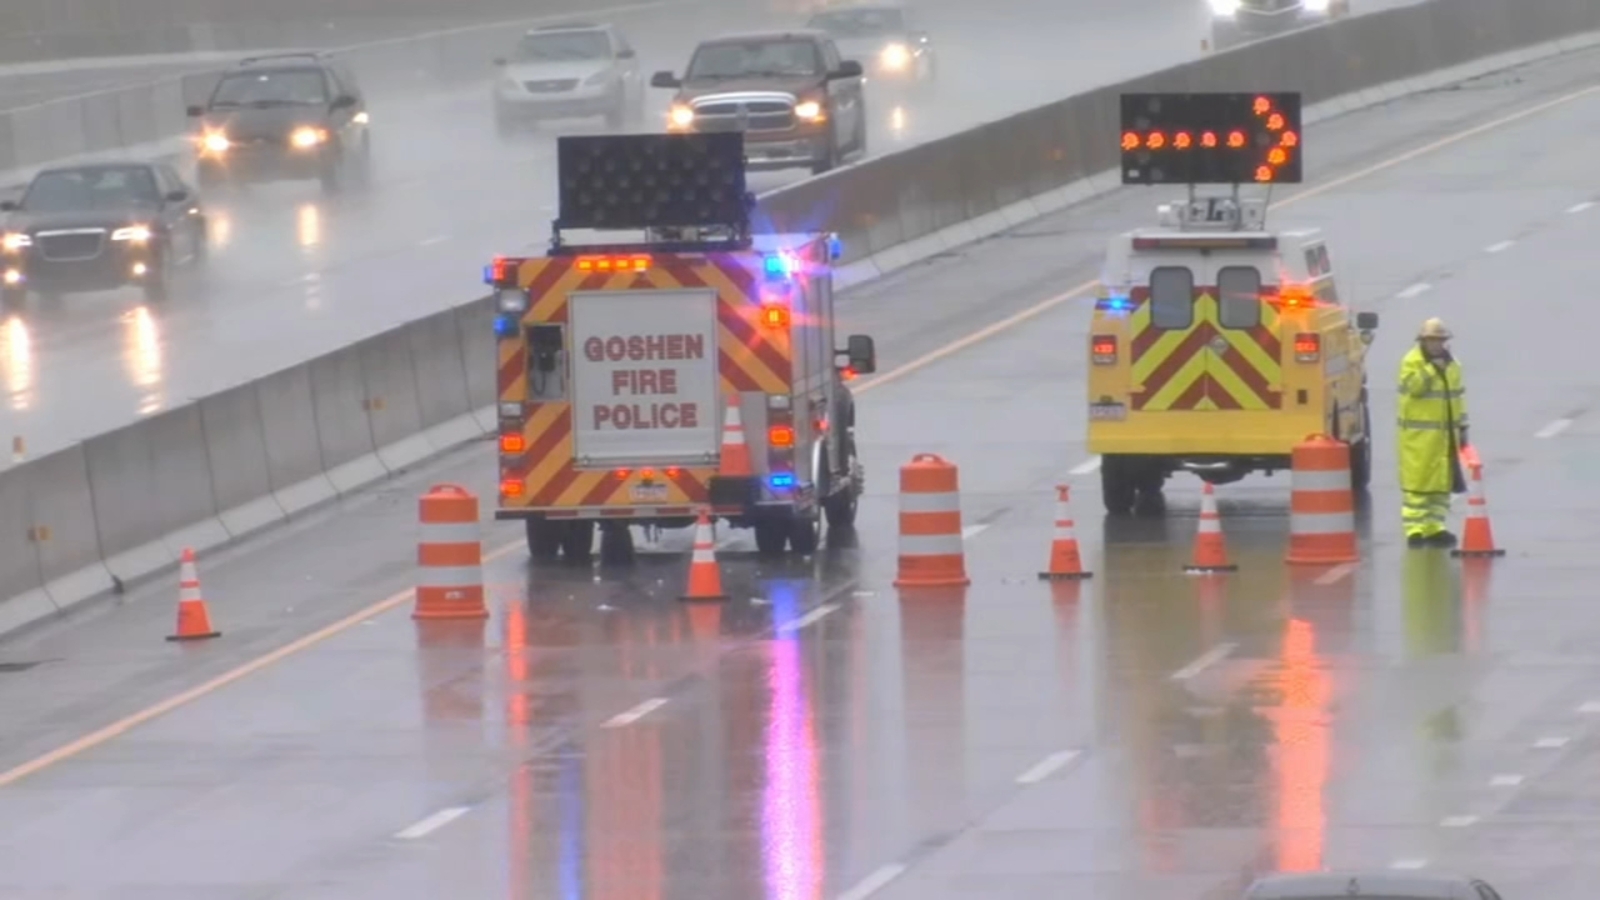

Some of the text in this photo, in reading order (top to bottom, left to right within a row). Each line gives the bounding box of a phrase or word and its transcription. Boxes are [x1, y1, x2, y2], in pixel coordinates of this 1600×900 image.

[584, 334, 704, 362] GOSHEN
[612, 369, 677, 395] FIRE
[593, 403, 698, 430] POLICE
